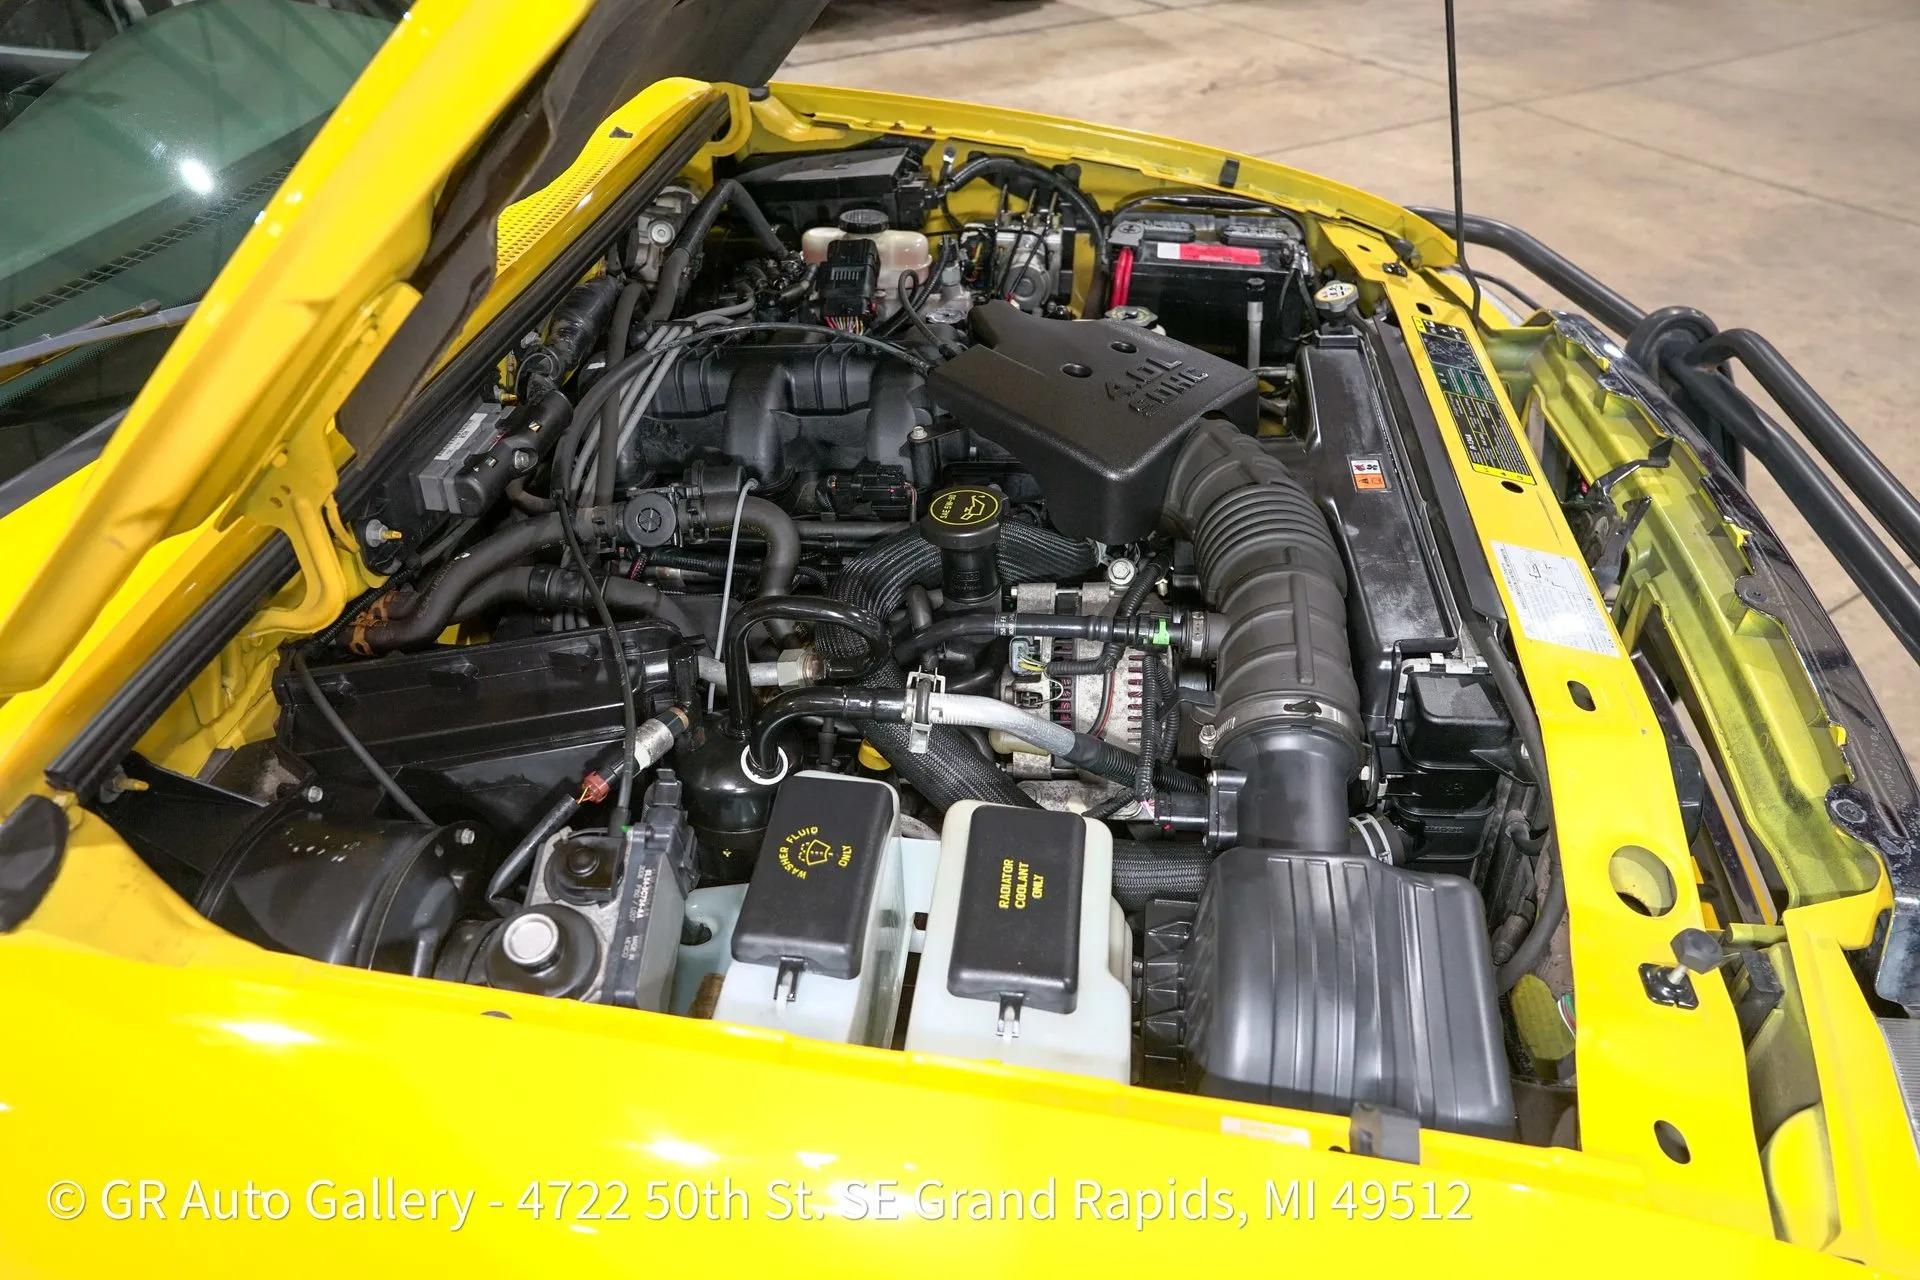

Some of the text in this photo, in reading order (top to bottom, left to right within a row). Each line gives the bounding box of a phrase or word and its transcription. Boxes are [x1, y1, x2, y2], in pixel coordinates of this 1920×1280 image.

[1105, 358, 1183, 402] 4.0L
[1128, 368, 1209, 417] SOHC
[779, 826, 819, 880] WASHER FLUID
[838, 845, 852, 867] ONLY
[998, 859, 1014, 909] RADIATOR
[1014, 861, 1029, 909] COOLANT
[1031, 873, 1044, 899] ONLY
